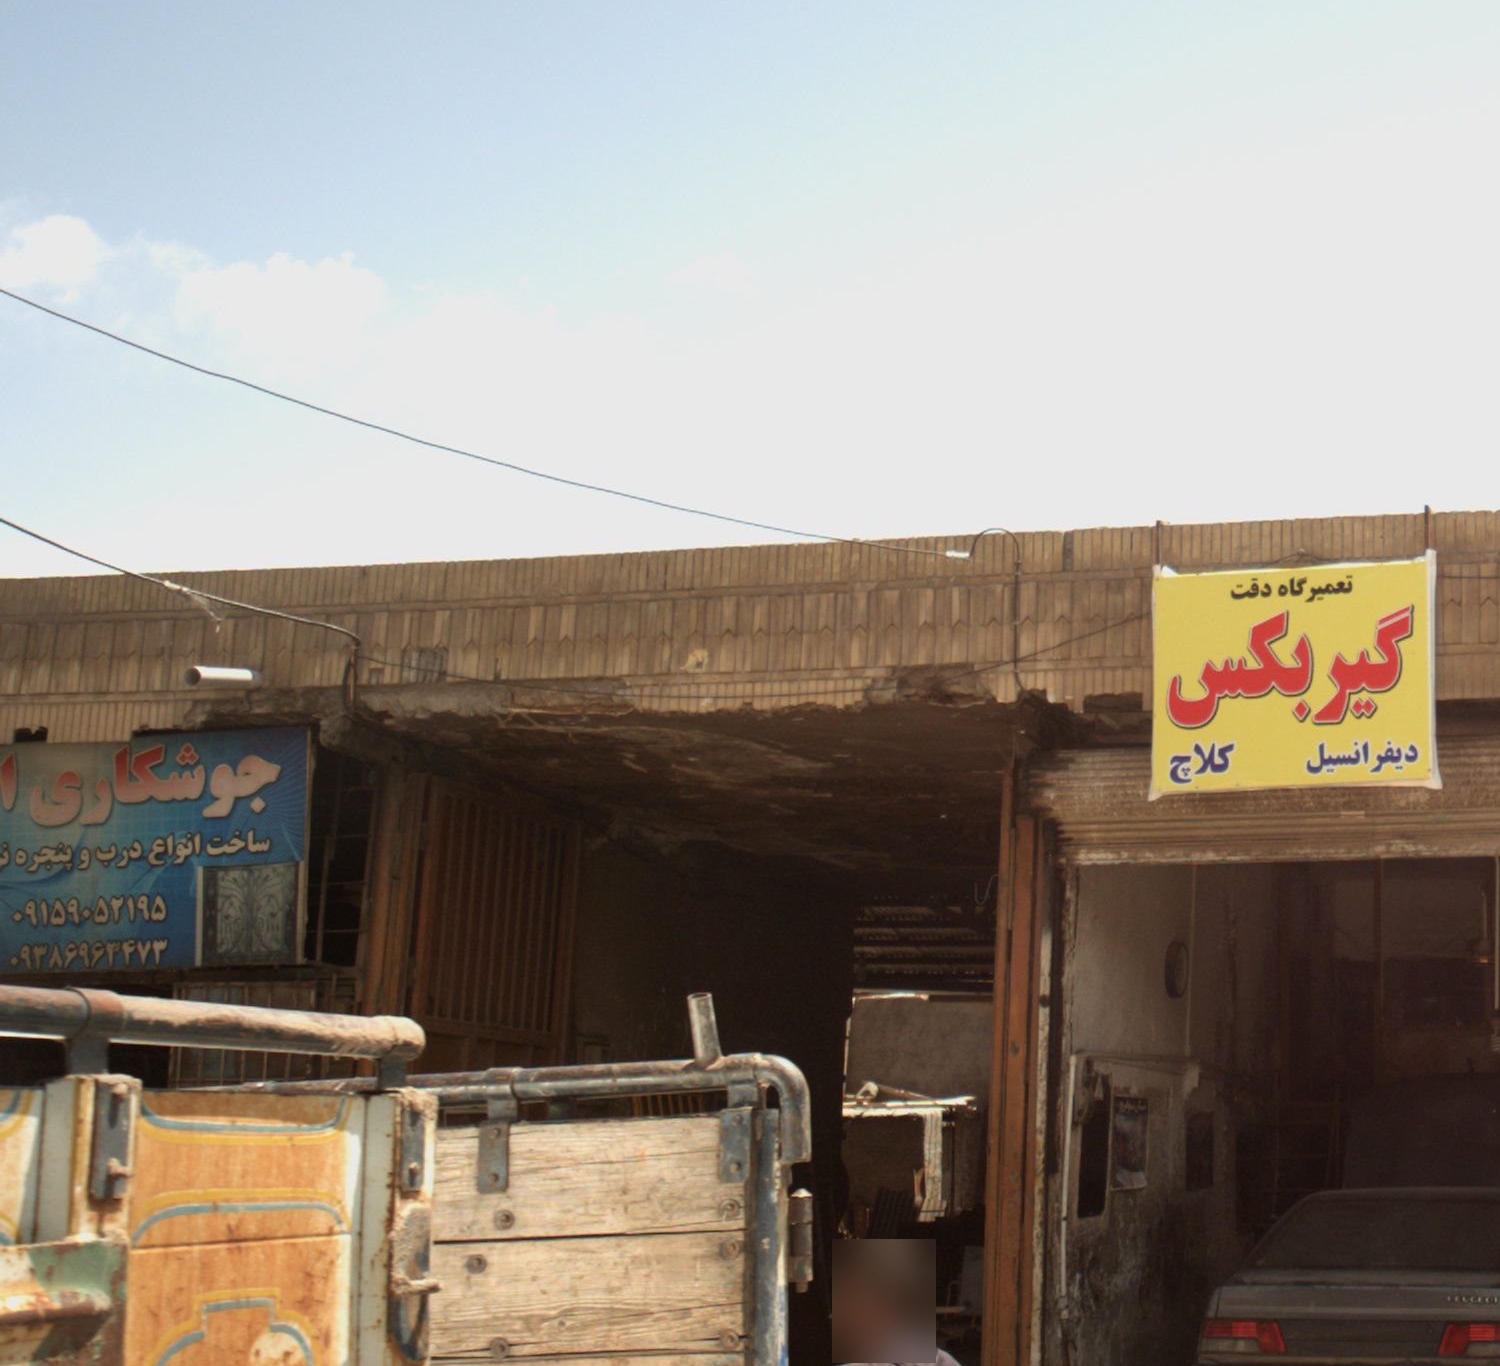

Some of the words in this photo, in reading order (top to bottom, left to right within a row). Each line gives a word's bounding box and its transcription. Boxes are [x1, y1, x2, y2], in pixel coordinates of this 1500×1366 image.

[1230, 578, 1272, 599] دقت
[1277, 575, 1354, 602] تعمیرگاه
[1168, 741, 1235, 784] کلاچ
[1306, 741, 1419, 774] دیفرانسیل
[29, 743, 281, 827] جوشکاری
[15, 842, 73, 874] پنجره
[78, 847, 91, 871] و
[95, 838, 141, 869] درب
[147, 833, 200, 866] انواع
[206, 830, 271, 857] ساخت
[12, 892, 168, 928] ۰۹۱۵۹۰۵۲۱۹۵
